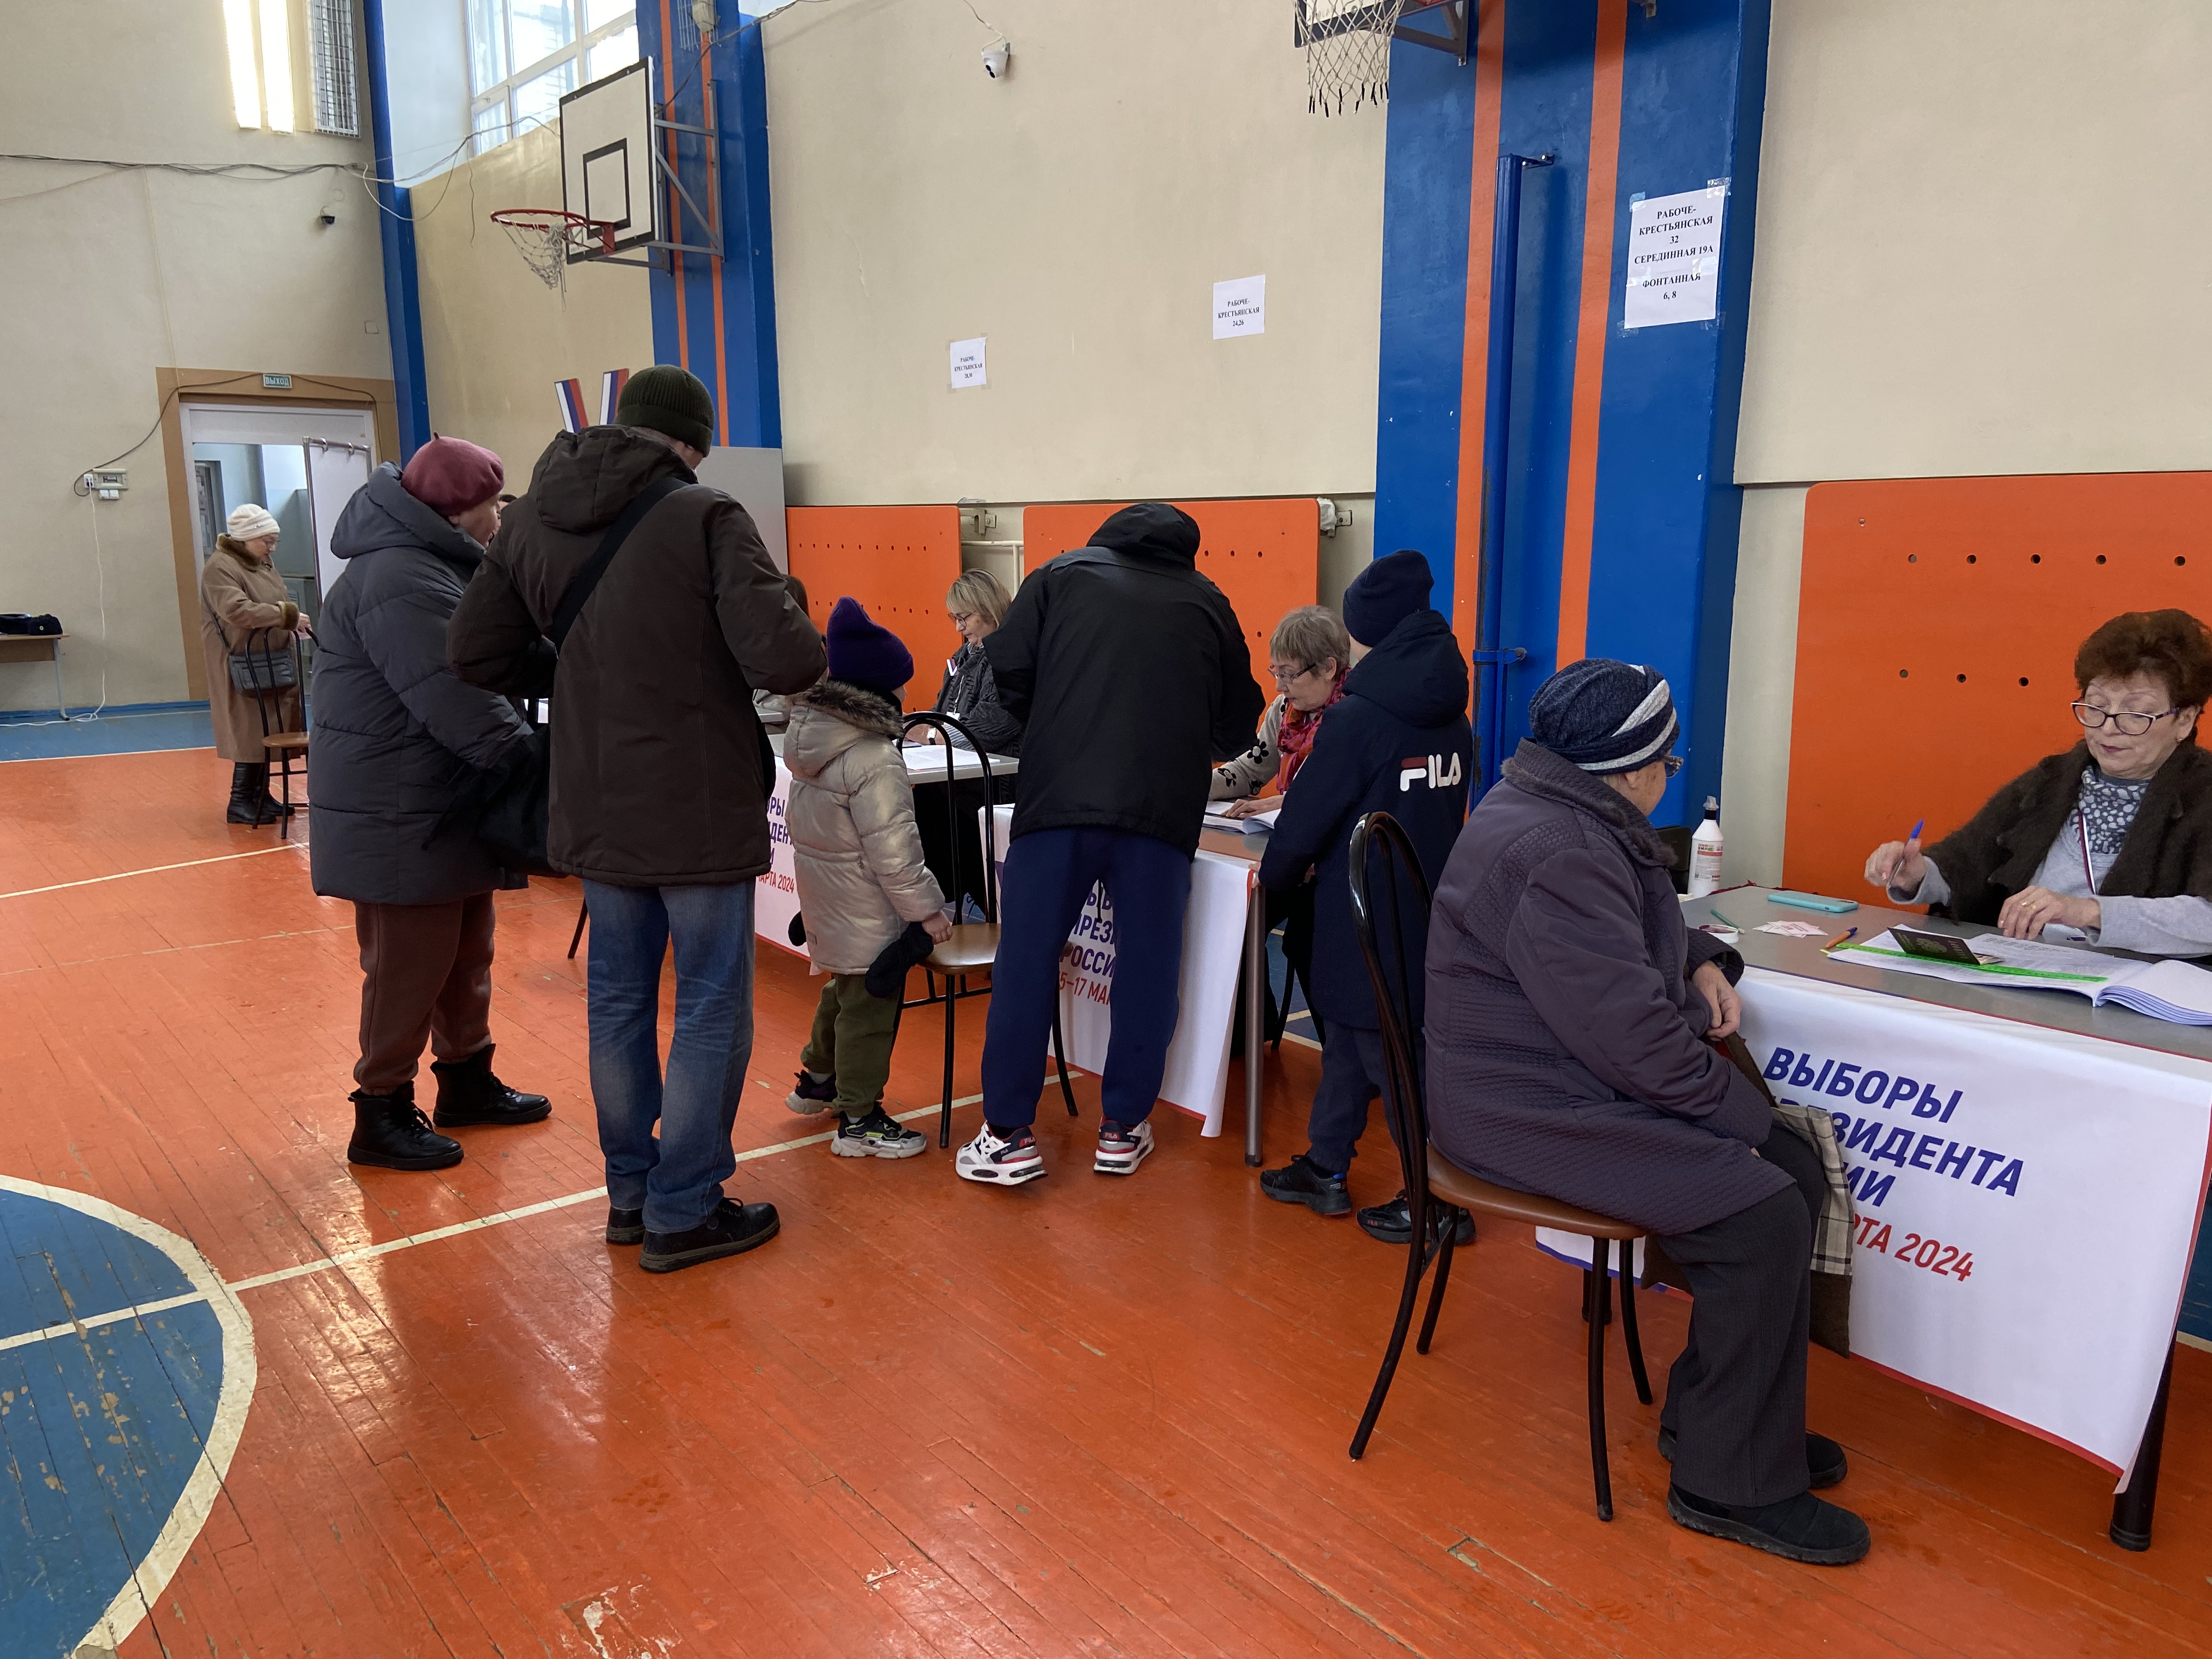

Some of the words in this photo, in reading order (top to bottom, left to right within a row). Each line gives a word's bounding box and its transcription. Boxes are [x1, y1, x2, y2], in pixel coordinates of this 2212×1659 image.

[1657, 206, 1696, 219] РАБОЧЕ-
[1639, 216, 1713, 236] КРЕСТЬЯНСКАЯ
[1669, 236, 1679, 244] 32
[1634, 247, 1696, 264] СЕРЕДИННАЯ
[1699, 245, 1713, 254] 19А
[1642, 273, 1701, 287] ФОНТАННАЯ
[1227, 298, 1250, 307] РАБОЧЕ-
[1663, 292, 1670, 301] 6,
[1672, 291, 1677, 299] 8
[1218, 307, 1260, 319] КРЕСТЬЯНСКАЯ
[265, 376, 289, 387] ВЫХОД
[1400, 752, 1462, 792] FILA
[777, 874, 795, 894] 2024
[1763, 1047, 1963, 1123] ВЫБОРЫ
[1774, 1097, 2024, 1197] ЗИДЕНТА
[1895, 1233, 1973, 1282] 2024
